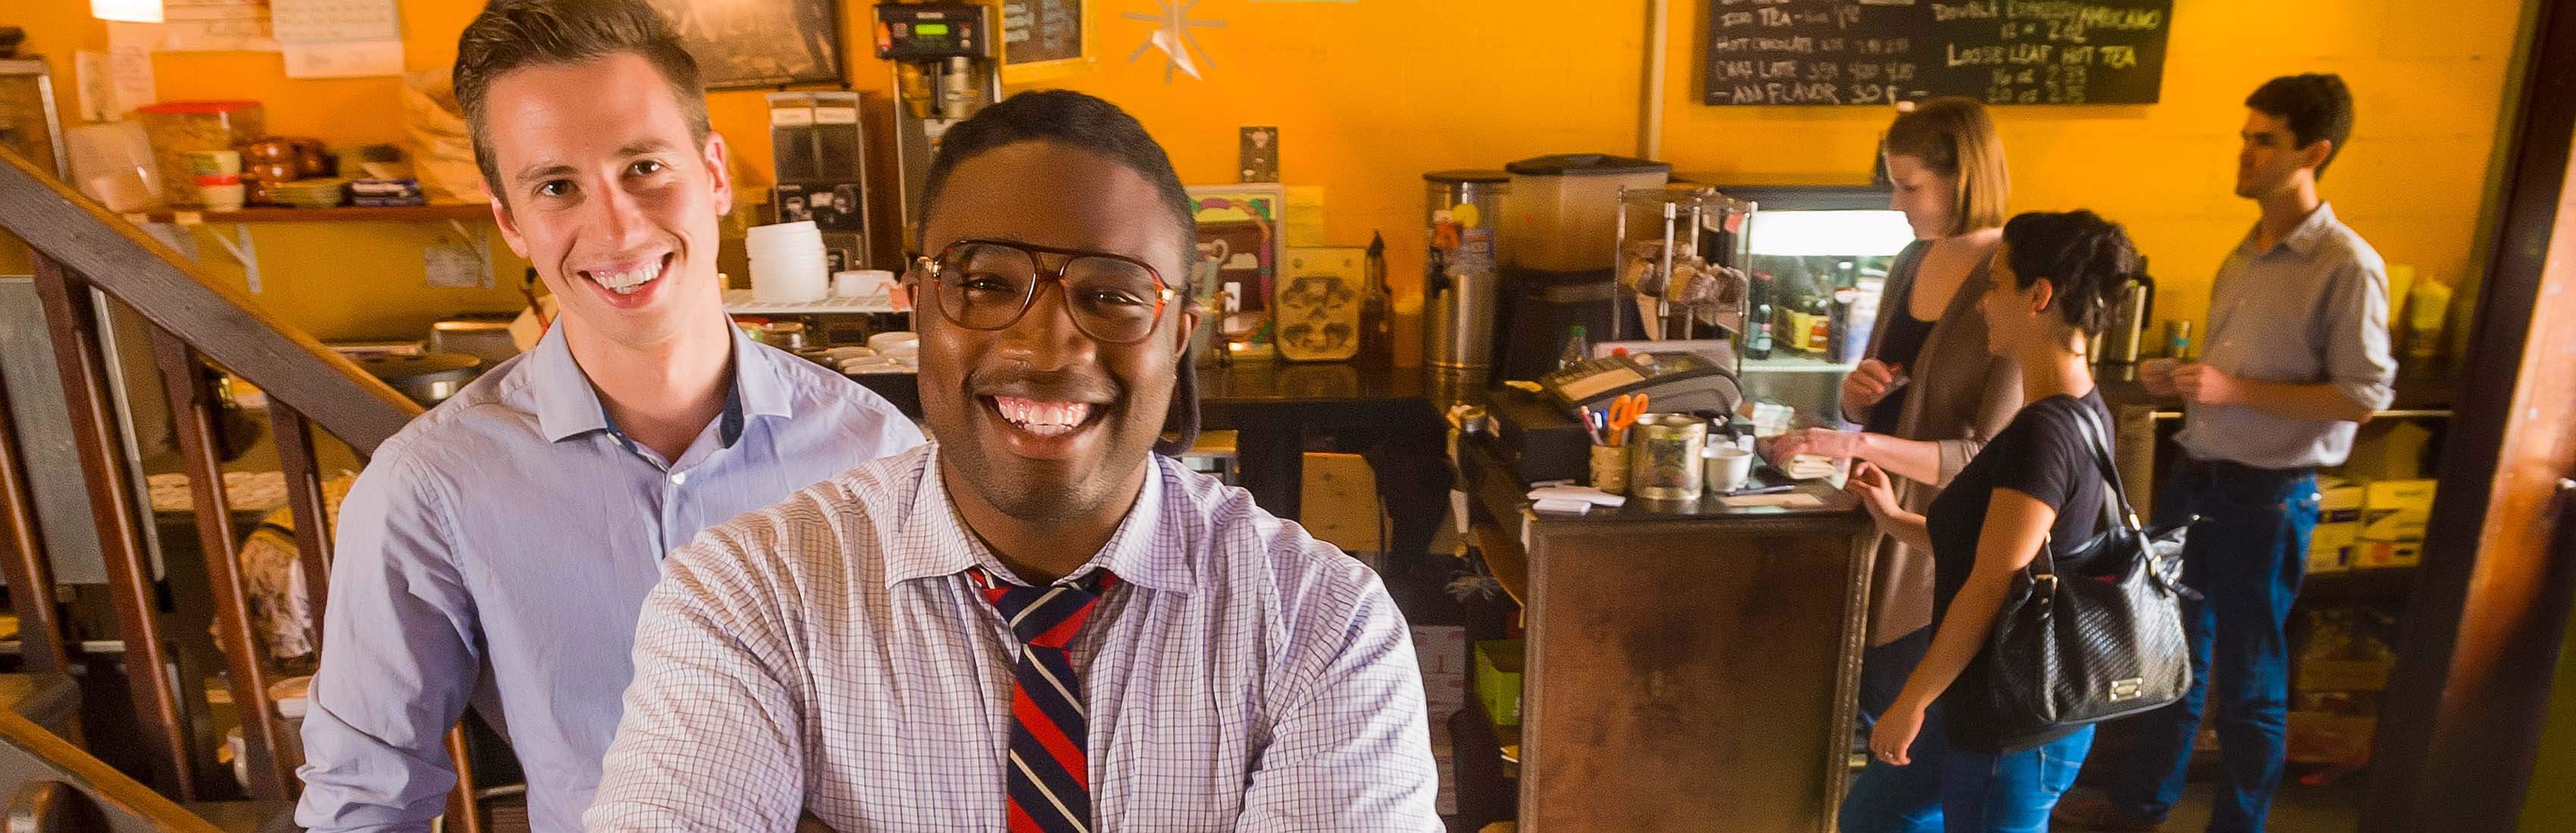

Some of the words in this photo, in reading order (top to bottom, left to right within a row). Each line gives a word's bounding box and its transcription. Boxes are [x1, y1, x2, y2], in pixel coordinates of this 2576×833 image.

[1758, 7, 1792, 27] TEA
[1716, 37, 1749, 52] HOT
[1946, 42, 2005, 67] LOOSE
[2009, 42, 2052, 65] LEAF
[2061, 45, 2094, 65] HOT
[2099, 45, 2137, 69] TEA
[1766, 82, 1841, 105] FLAVOR
